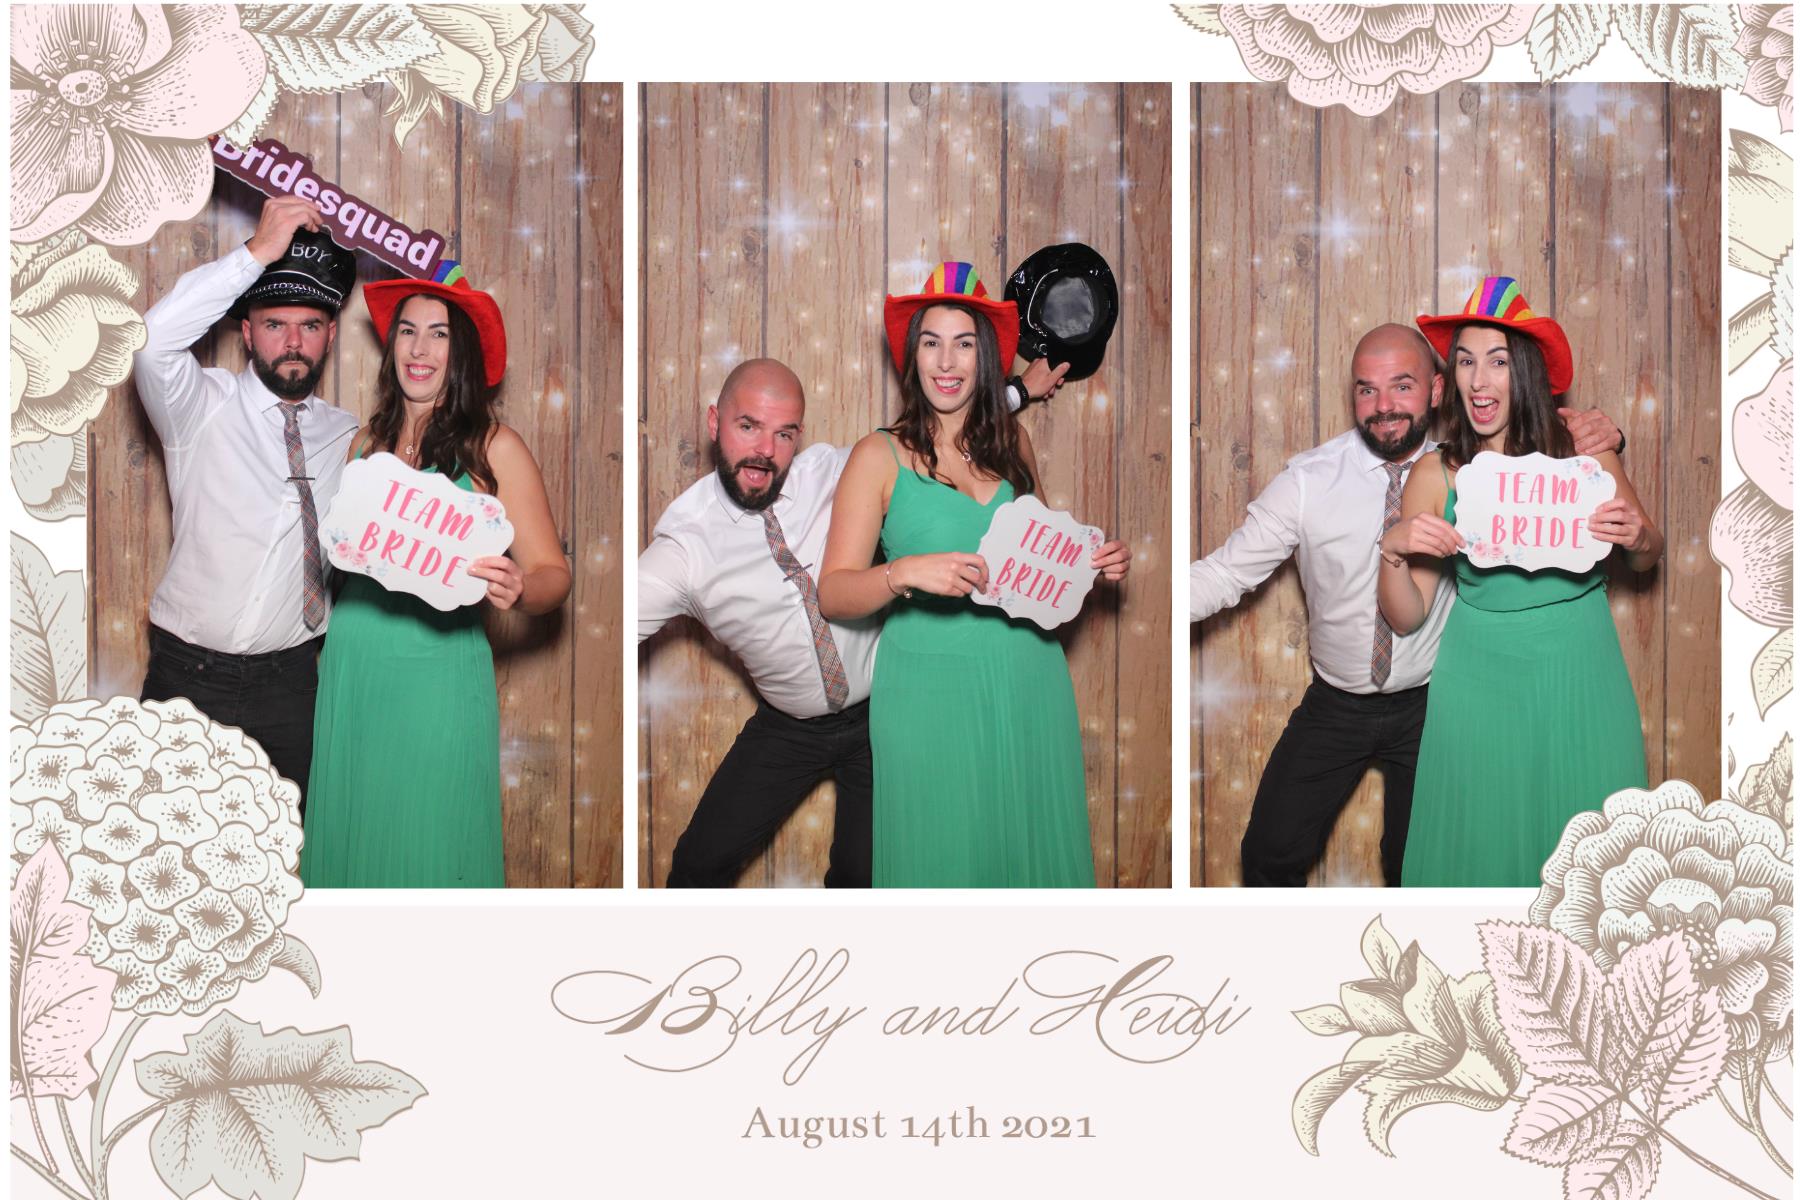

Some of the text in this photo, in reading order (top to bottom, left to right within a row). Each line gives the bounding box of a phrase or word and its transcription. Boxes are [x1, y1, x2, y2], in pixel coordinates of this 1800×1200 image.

[291, 242, 332, 263] BOY
[383, 479, 475, 542] TEAM
[1495, 472, 1580, 504] TEAM
[358, 522, 470, 588] BRIDE
[1019, 519, 1083, 567] TEAM
[1490, 514, 1587, 549] BRIDE
[998, 557, 1073, 609] BRIDE
